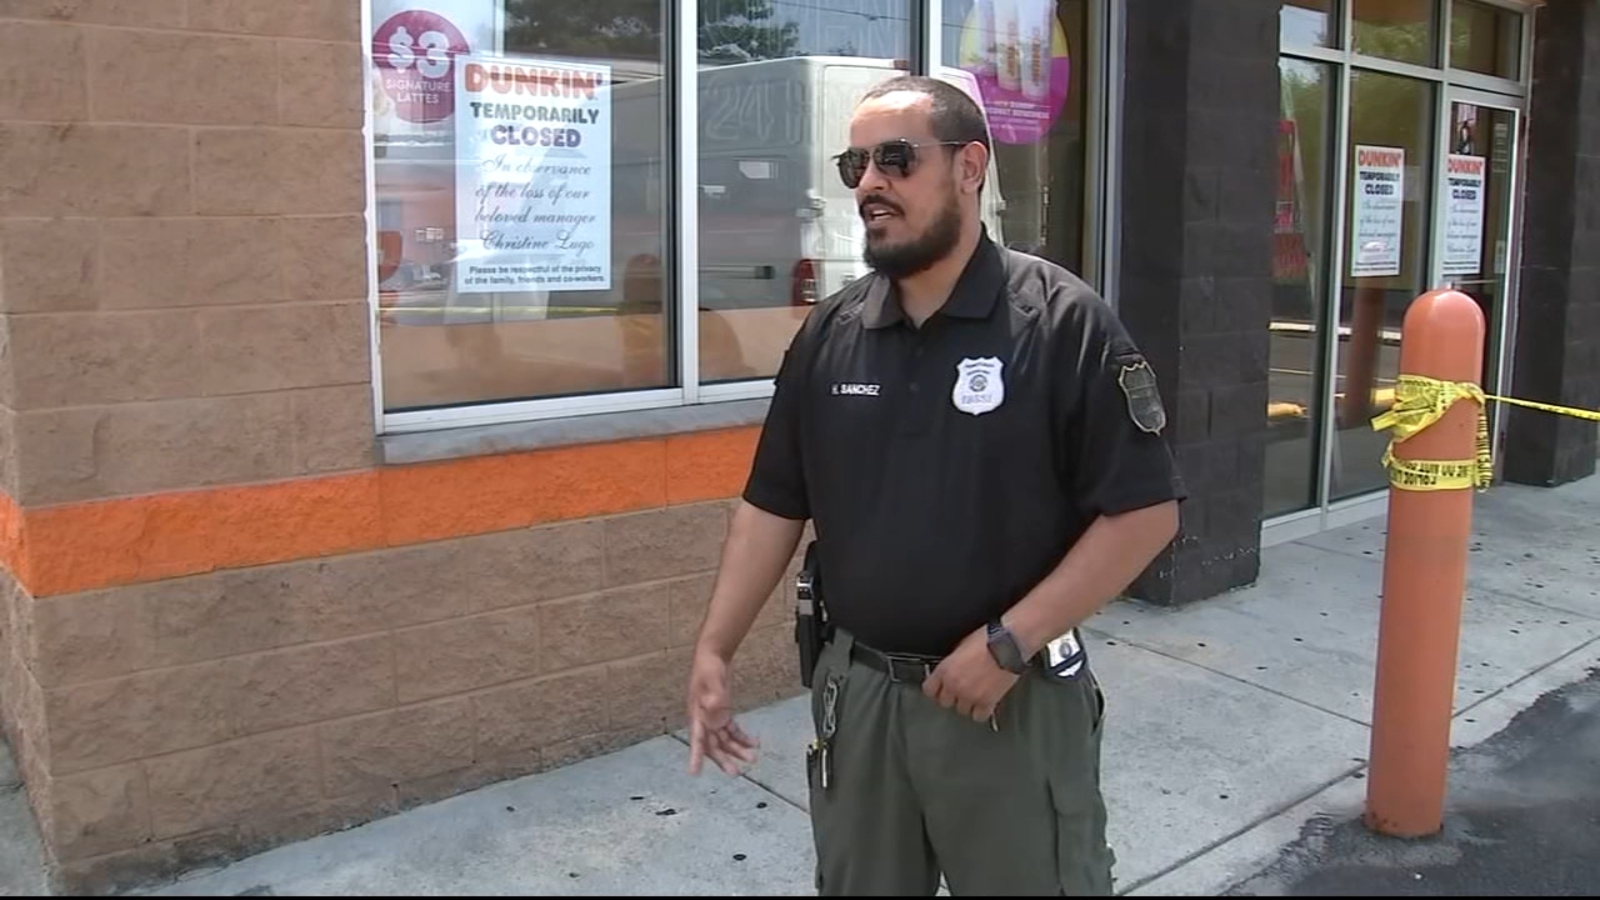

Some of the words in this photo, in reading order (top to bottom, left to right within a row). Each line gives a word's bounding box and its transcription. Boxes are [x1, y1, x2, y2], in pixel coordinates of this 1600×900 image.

[388, 25, 451, 79] $3
[386, 79, 452, 92] SIGNATURE
[464, 63, 603, 101] DUNKIN'
[396, 92, 440, 104] LATTES
[469, 102, 600, 124] TEMPORARILY
[490, 124, 581, 147] CLOSED
[481, 153, 511, 173] In
[475, 182, 494, 205] of
[494, 181, 517, 199] the
[520, 181, 545, 199] loss
[547, 182, 567, 206] of
[564, 189, 590, 199] our
[1364, 183, 1394, 195] CLOSED
[474, 205, 532, 223] beloved
[533, 214, 597, 230] manager
[479, 229, 549, 250] Christine
[554, 229, 596, 257] Lugo
[469, 265, 496, 275] Please
[498, 265, 509, 274] be
[561, 264, 573, 273] the
[574, 264, 601, 275] privacy
[464, 276, 473, 285] of
[474, 276, 488, 285] the
[840, 383, 881, 396] SANCHEZ
